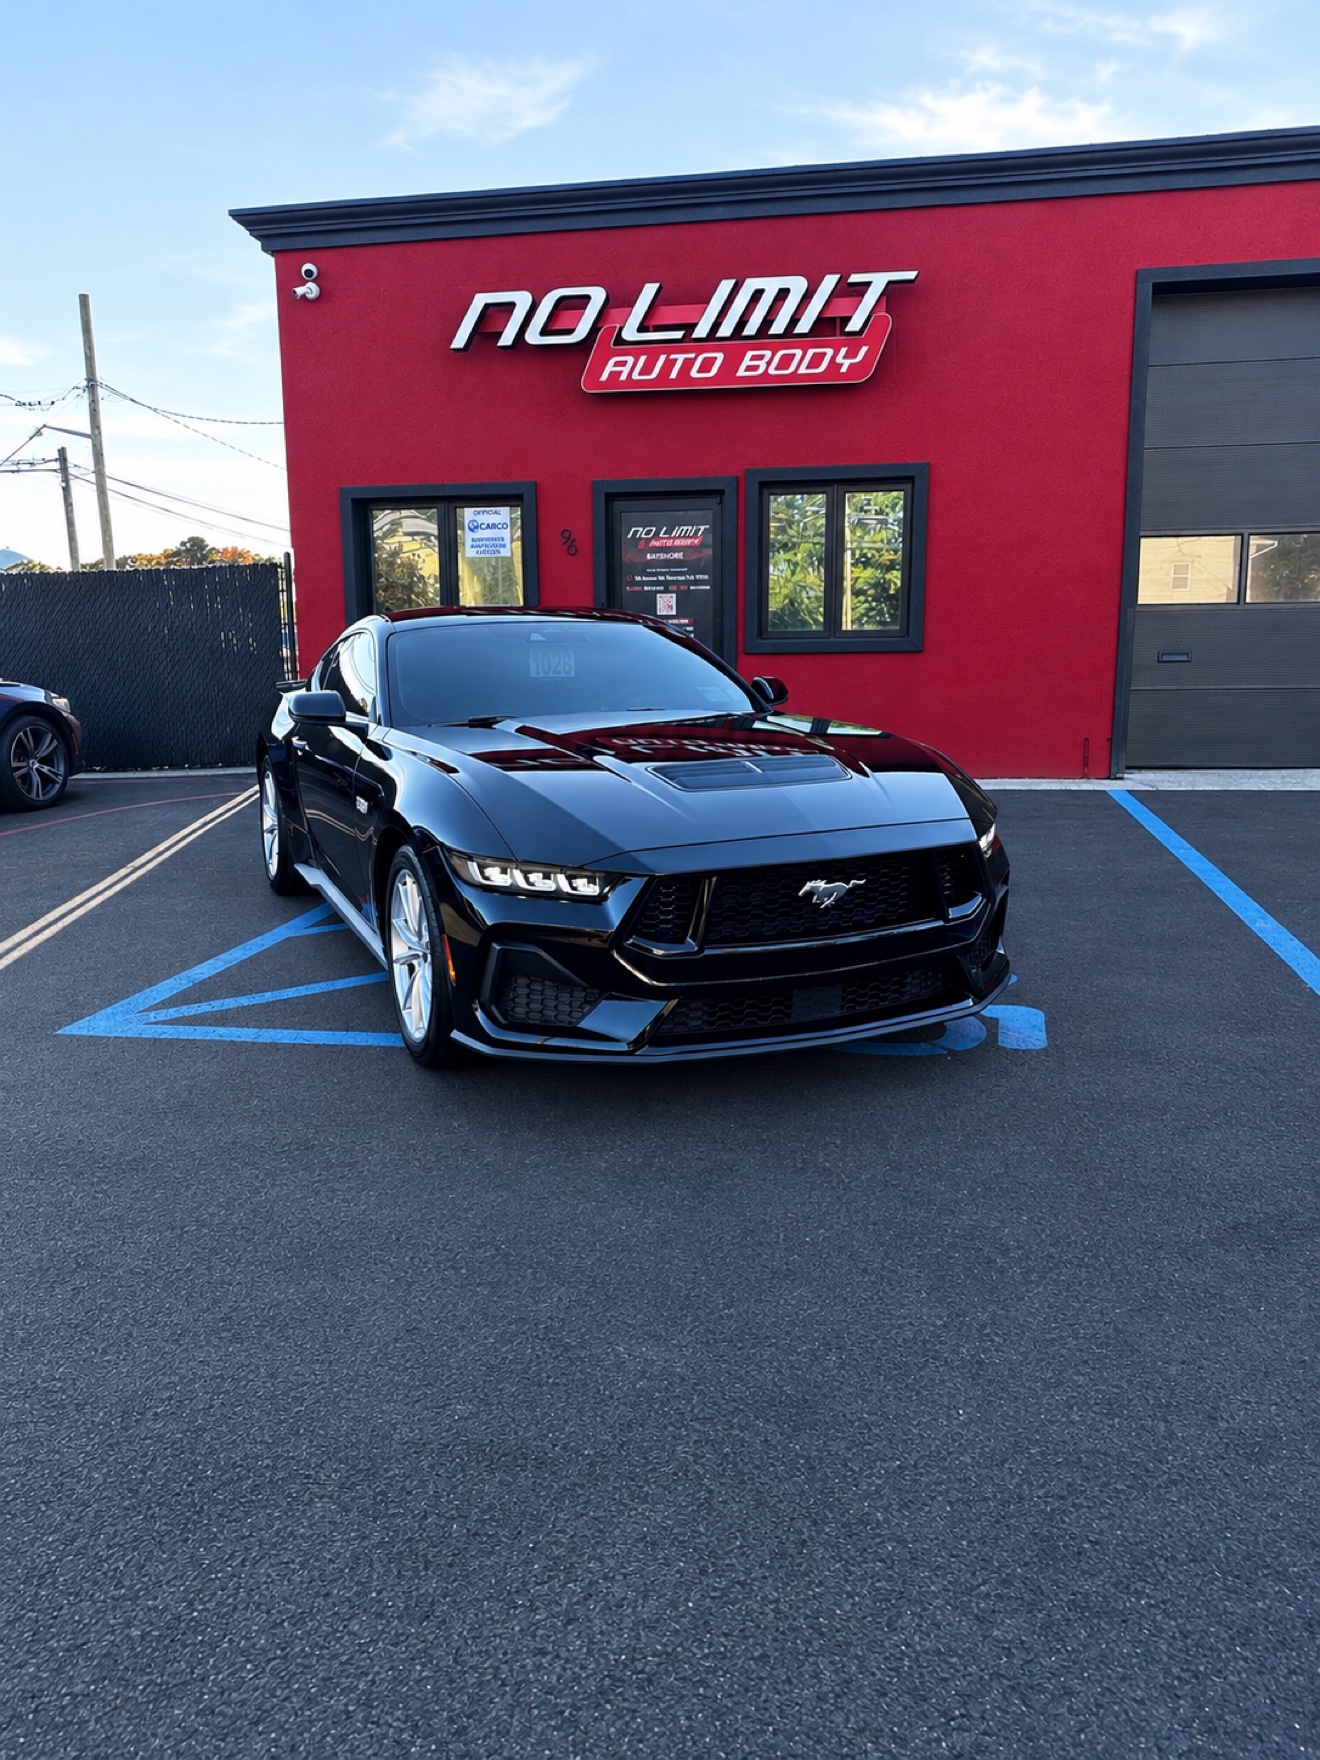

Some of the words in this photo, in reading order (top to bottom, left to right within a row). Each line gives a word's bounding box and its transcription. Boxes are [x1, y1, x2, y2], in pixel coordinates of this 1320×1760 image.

[450, 286, 607, 350] NO
[621, 270, 919, 342] LIMIT
[599, 351, 724, 382] AUTO
[736, 345, 868, 378] BODY
[479, 522, 509, 531] CARCO
[627, 526, 656, 539] NO
[659, 525, 710, 538] LIMIT
[560, 528, 578, 557] 96
[530, 652, 573, 676] 1026
